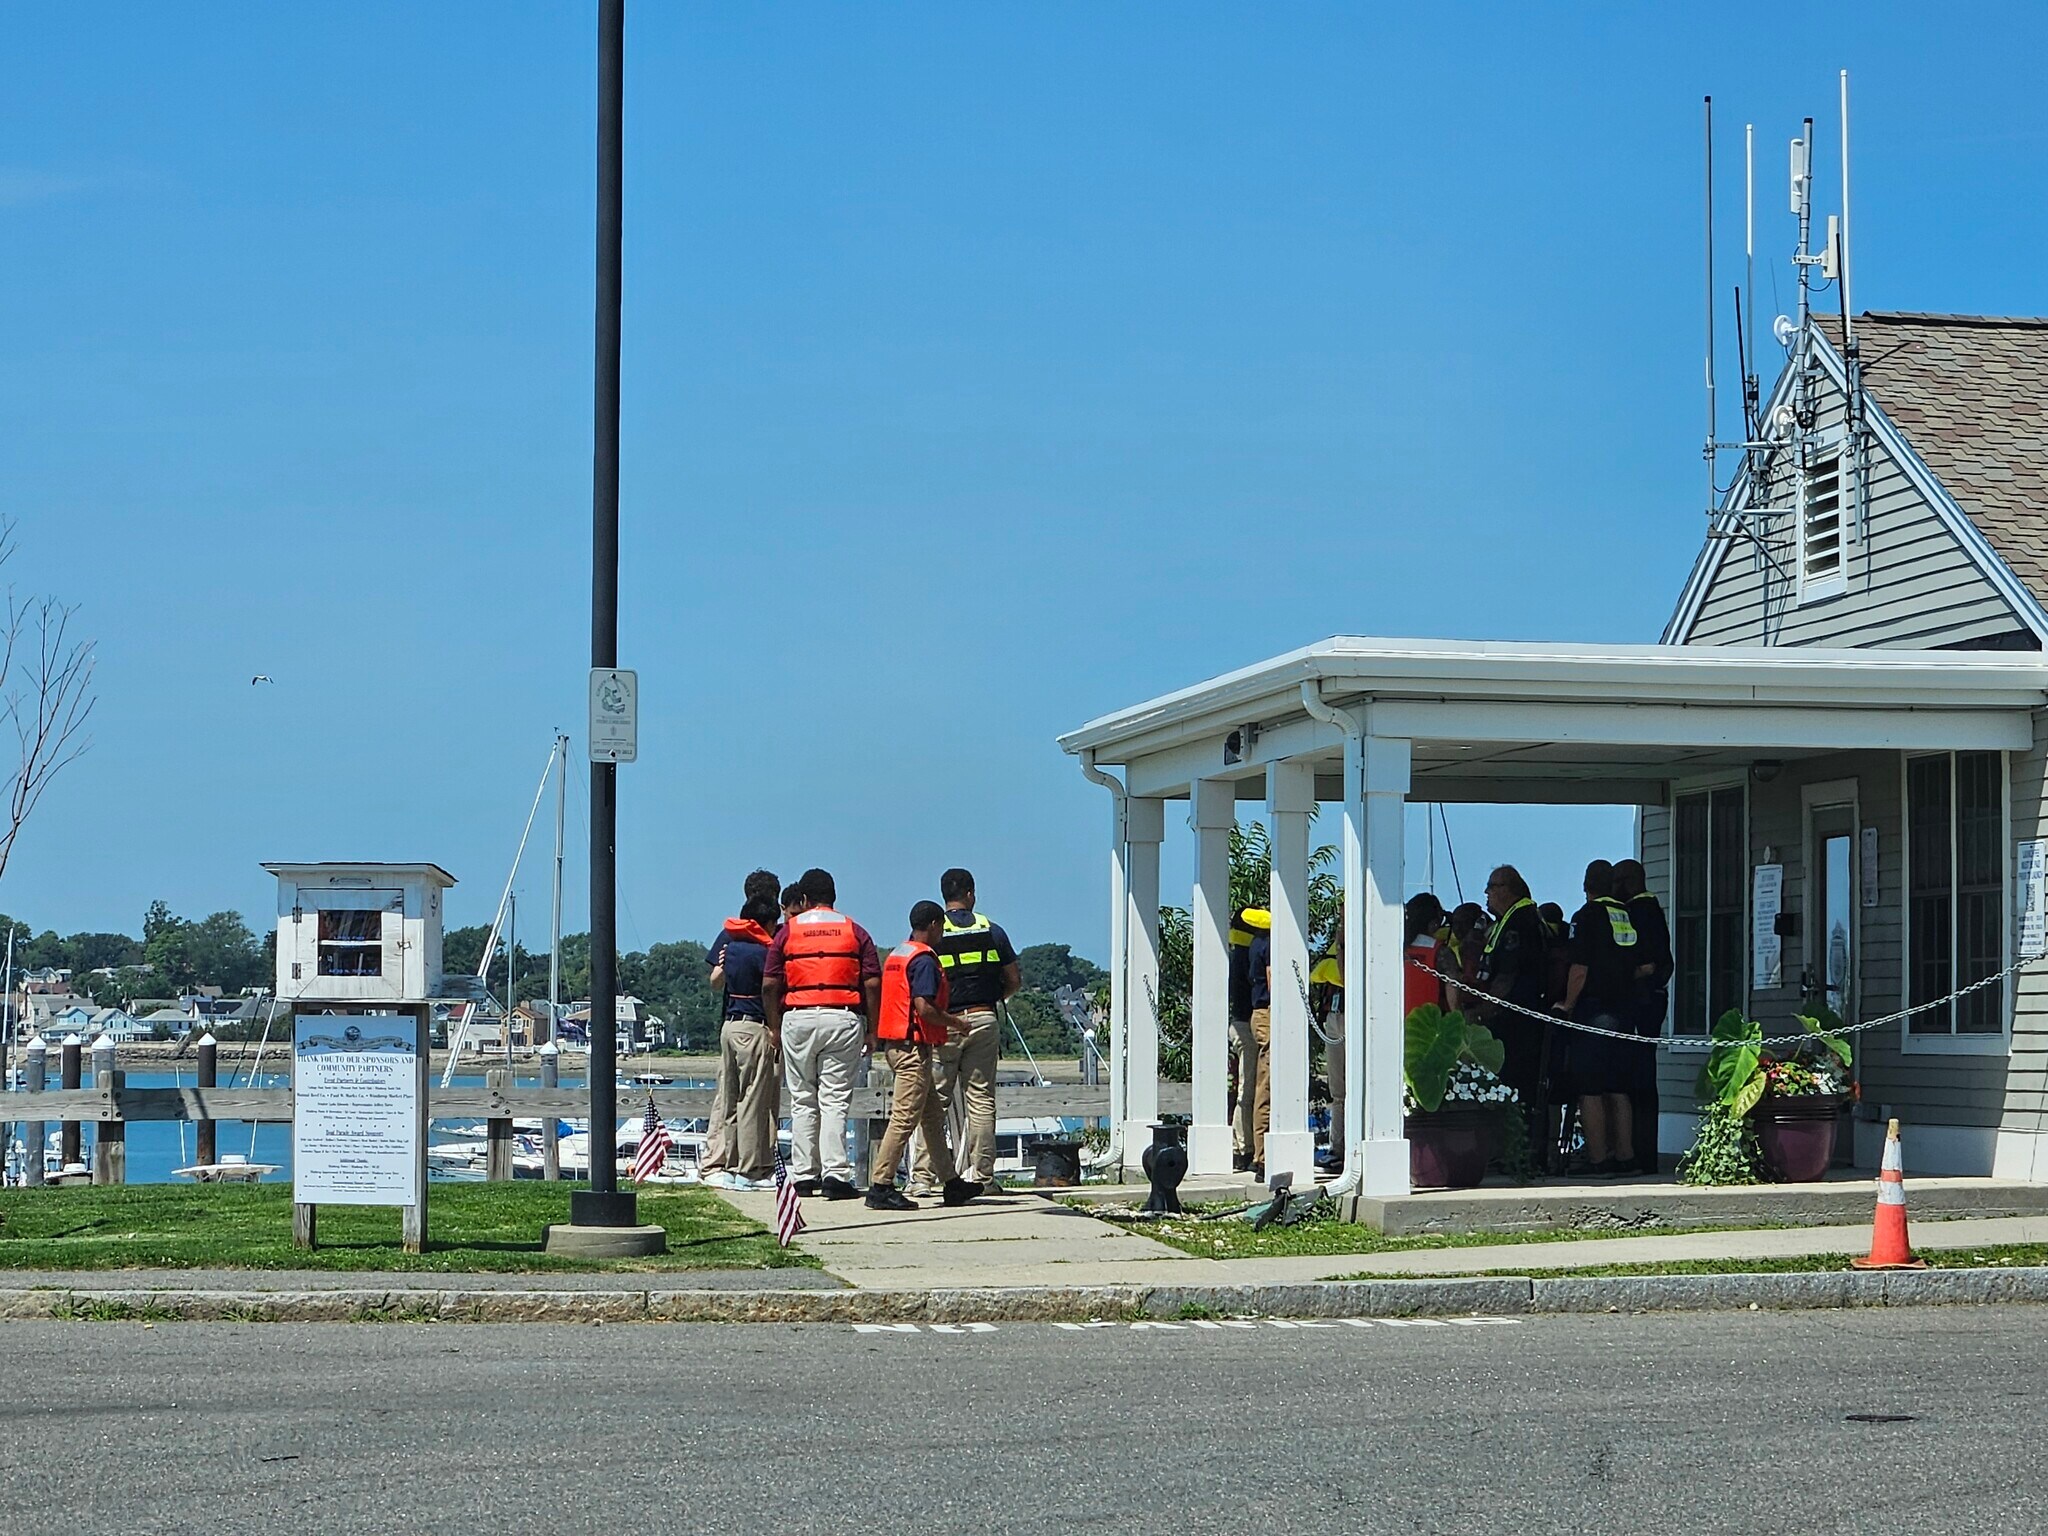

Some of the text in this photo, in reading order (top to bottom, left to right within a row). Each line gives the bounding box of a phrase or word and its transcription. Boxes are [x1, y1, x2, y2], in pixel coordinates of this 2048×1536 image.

[297, 1055, 414, 1064] THANK YOU TO OUR SPONSORS AND
[316, 1064, 394, 1073] COMMUNITY PARTNERS
